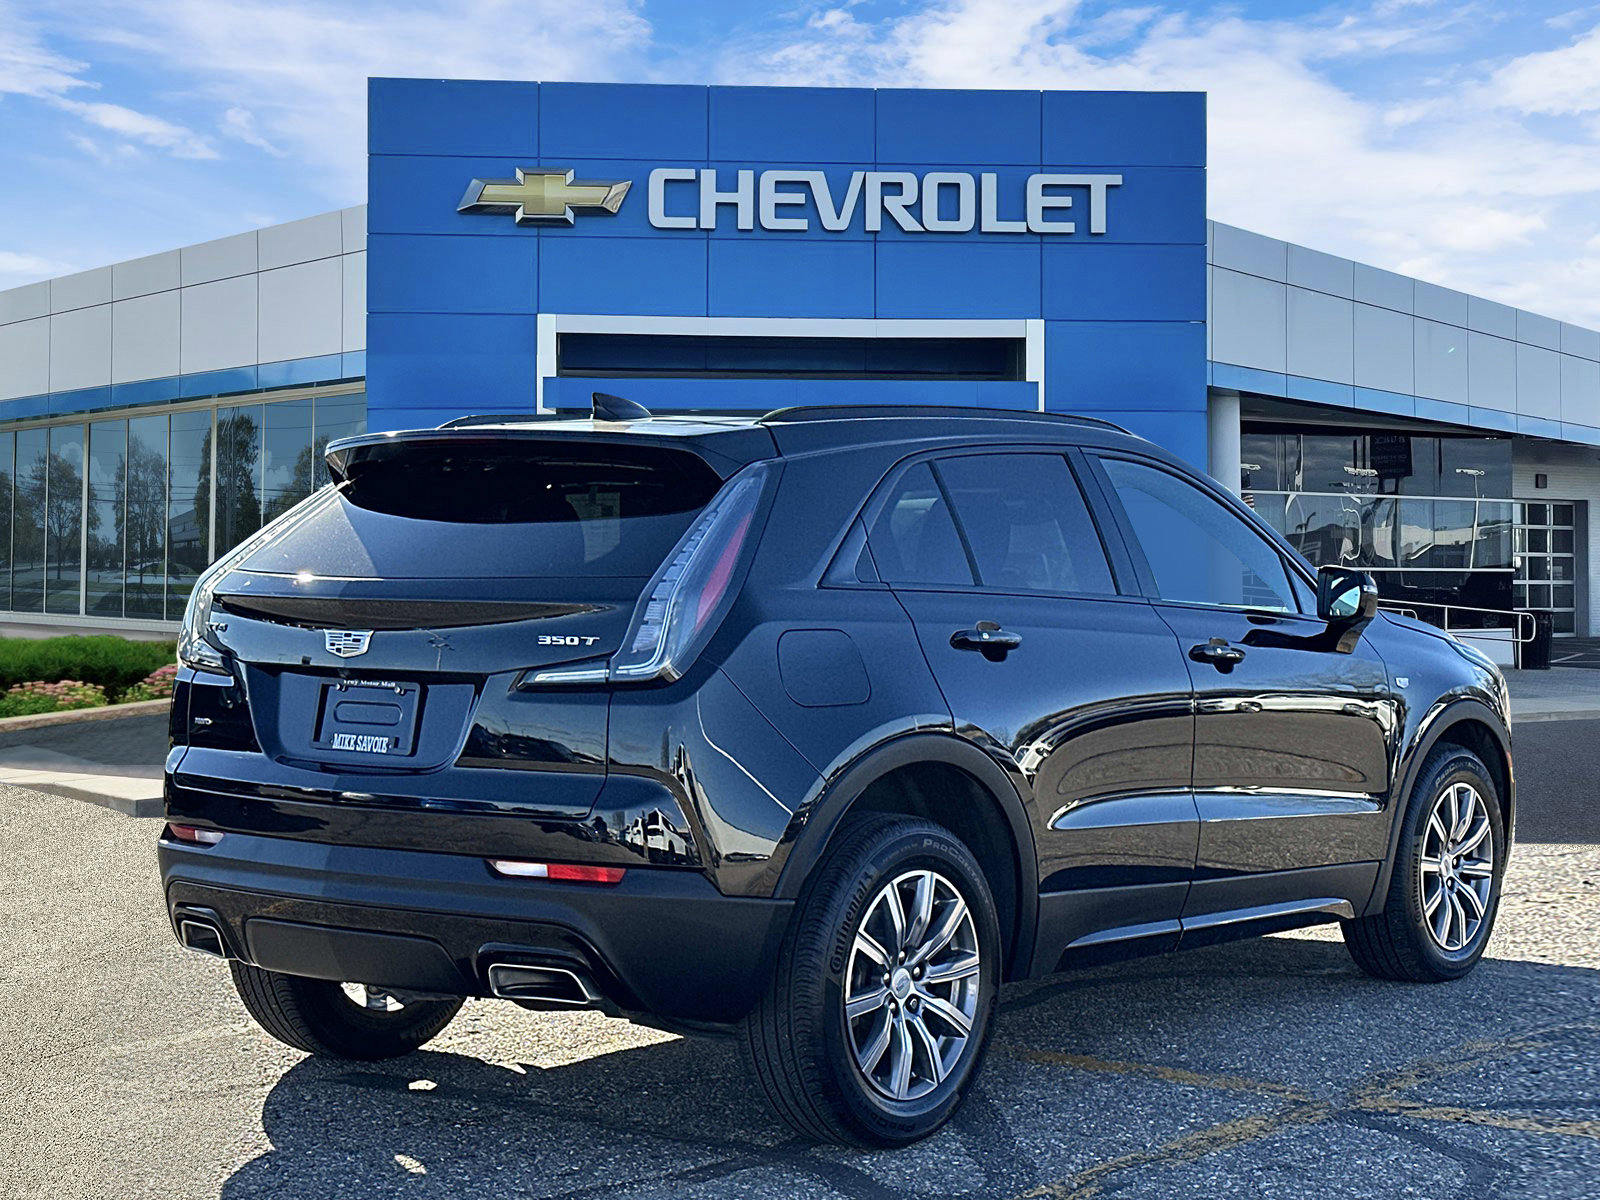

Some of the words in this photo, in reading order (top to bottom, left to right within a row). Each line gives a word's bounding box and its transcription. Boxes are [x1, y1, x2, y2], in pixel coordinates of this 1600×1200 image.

[648, 168, 1123, 234] CHEVROLET
[538, 635, 600, 646] 350T
[332, 733, 357, 750] MIKE
[356, 735, 389, 753] SAVOIE
[830, 879, 868, 975] Continental
